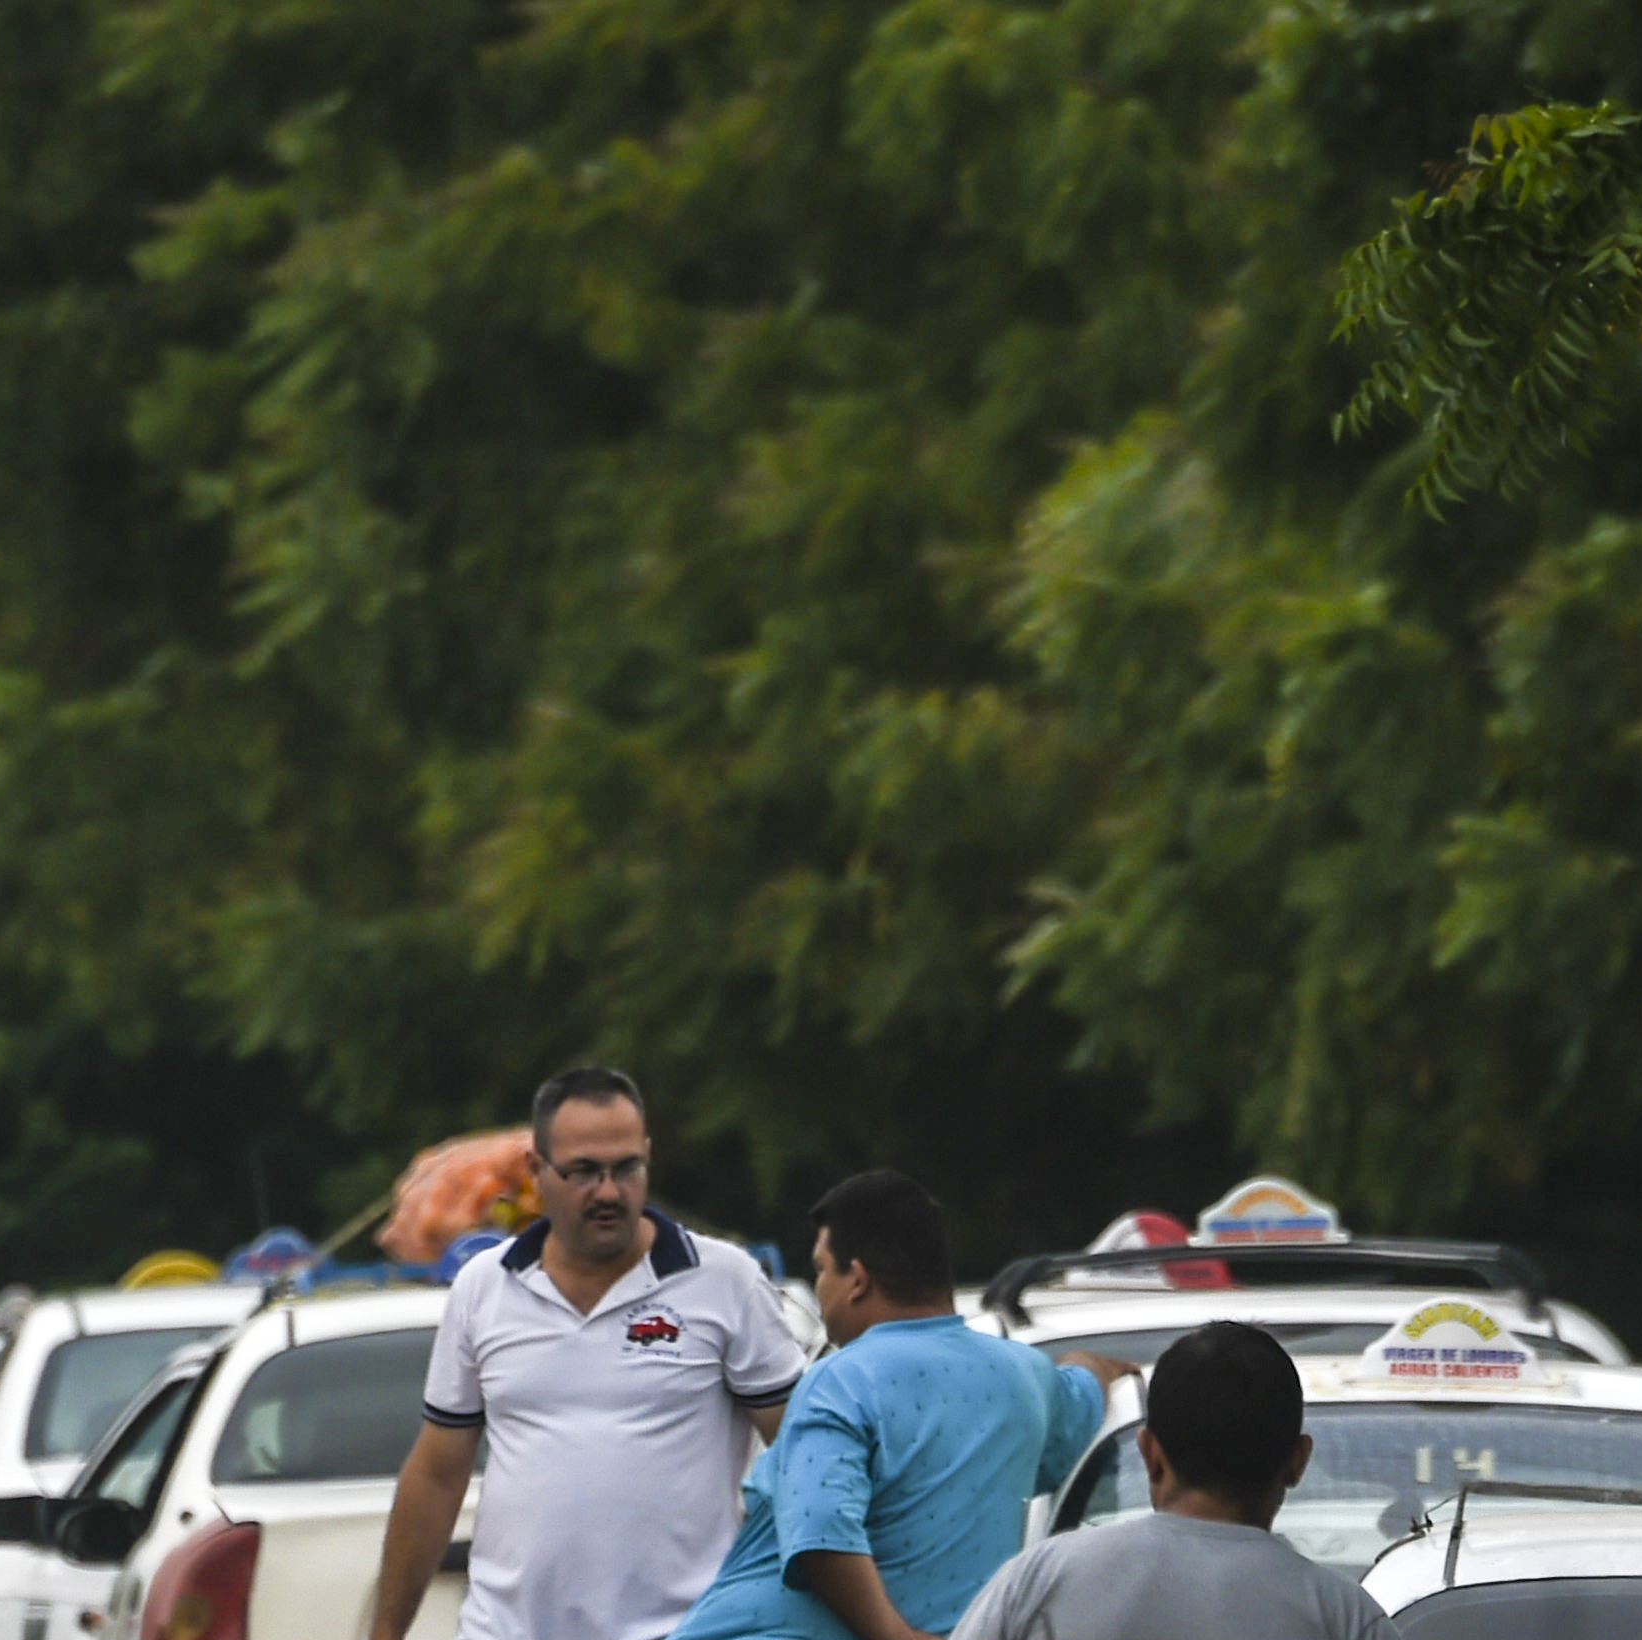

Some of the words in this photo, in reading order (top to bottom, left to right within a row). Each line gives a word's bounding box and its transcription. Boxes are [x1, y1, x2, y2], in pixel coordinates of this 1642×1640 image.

[1384, 1347, 1436, 1362] VIRGEN
[1440, 1348, 1458, 1362] DE
[1462, 1348, 1528, 1365] LOURDES
[1389, 1362, 1439, 1377] AGUAS
[1443, 1363, 1521, 1379] CALIENTES
